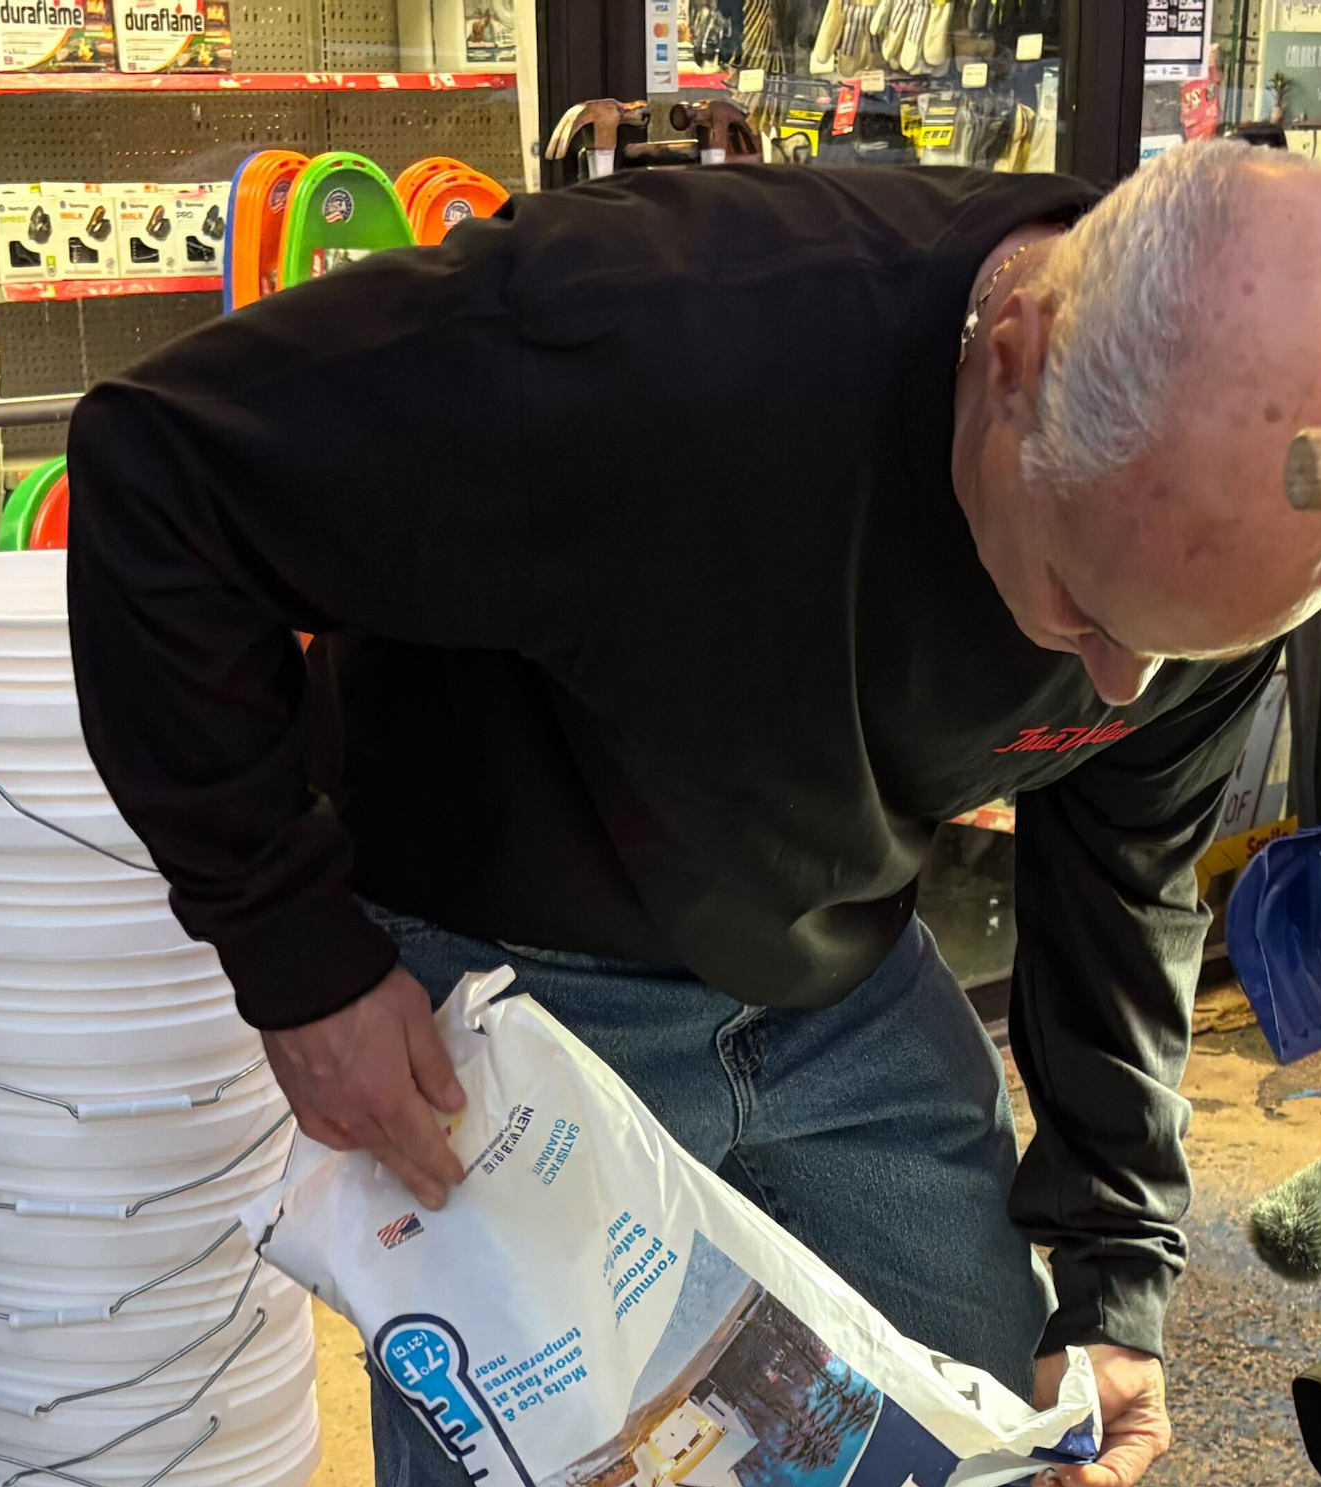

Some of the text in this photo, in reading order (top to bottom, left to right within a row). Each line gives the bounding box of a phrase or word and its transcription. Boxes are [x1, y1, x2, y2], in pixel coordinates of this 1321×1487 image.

[0, 2, 82, 26] duraflame
[125, 7, 203, 32] duraflame
[1286, 45, 1315, 68] COLORS
[514, 1106, 534, 1133] NET
[474, 1353, 507, 1379] near
[482, 1326, 582, 1392] temperatures
[491, 1344, 583, 1408] snow fast at
[502, 1363, 587, 1422] Melts ice &
